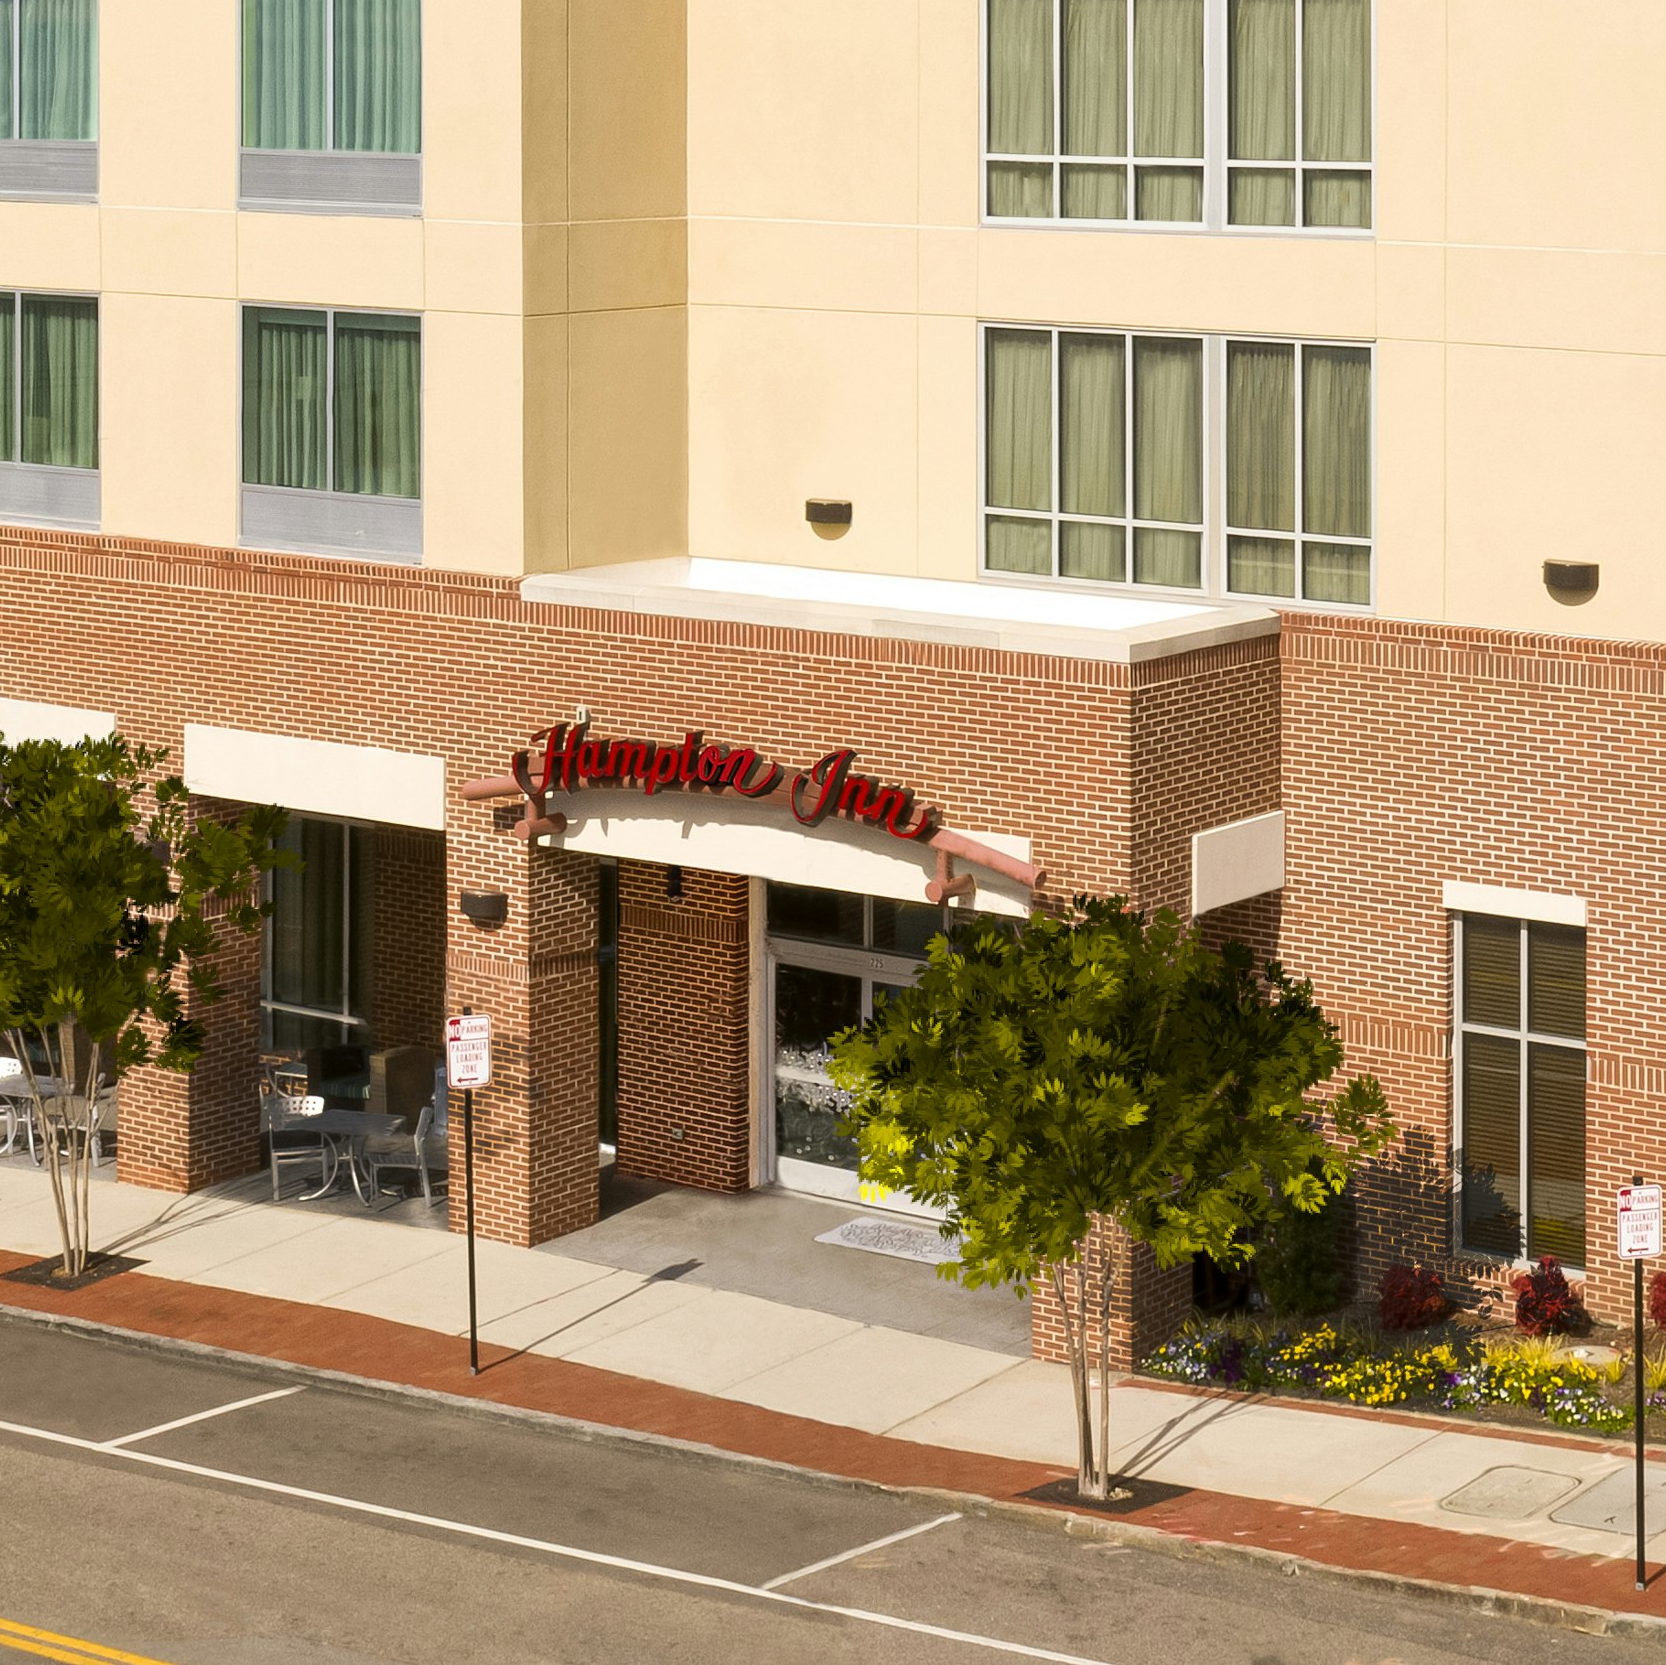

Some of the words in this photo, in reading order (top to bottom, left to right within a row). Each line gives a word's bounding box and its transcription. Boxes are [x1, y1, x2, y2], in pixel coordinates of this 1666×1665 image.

[512, 721, 784, 797] Hampton
[790, 749, 935, 840] Inn
[449, 1024, 461, 1039] NO
[461, 1023, 488, 1034] PARKING
[452, 1041, 487, 1052] PASSENGER
[456, 1053, 483, 1063] LOADING
[461, 1064, 478, 1074] ZONE
[1620, 1194, 1632, 1209] NO
[1632, 1194, 1659, 1205] PARKING
[1622, 1212, 1658, 1222] PASSENGER
[1627, 1223, 1654, 1233] LOADING
[1632, 1234, 1648, 1245] ZONE
